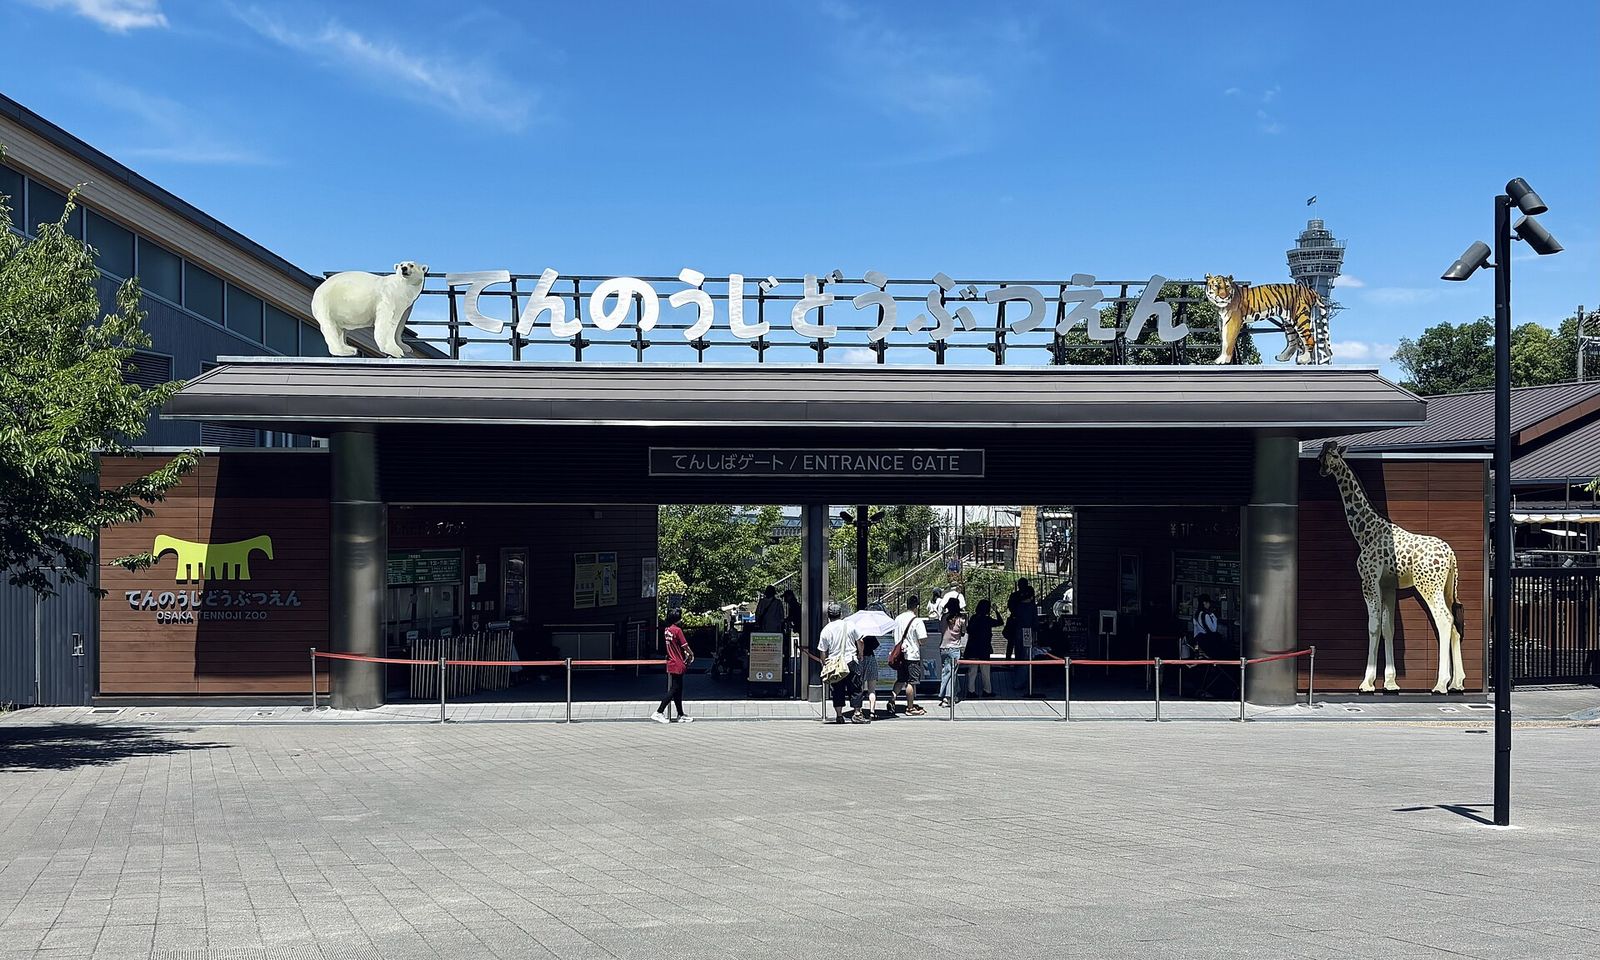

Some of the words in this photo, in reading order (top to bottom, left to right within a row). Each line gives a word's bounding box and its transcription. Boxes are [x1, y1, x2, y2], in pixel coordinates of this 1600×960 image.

[446, 267, 1189, 342] てんのうじどうぶつえん
[671, 453, 784, 471] てんしばゲート
[803, 455, 904, 471] ENTRANCE
[911, 455, 960, 471] GATE
[125, 589, 302, 608] てんのうじどうぶつえん
[156, 610, 194, 621] OSAKA
[197, 610, 242, 621] TENNOJI
[245, 610, 268, 621] ZOO
